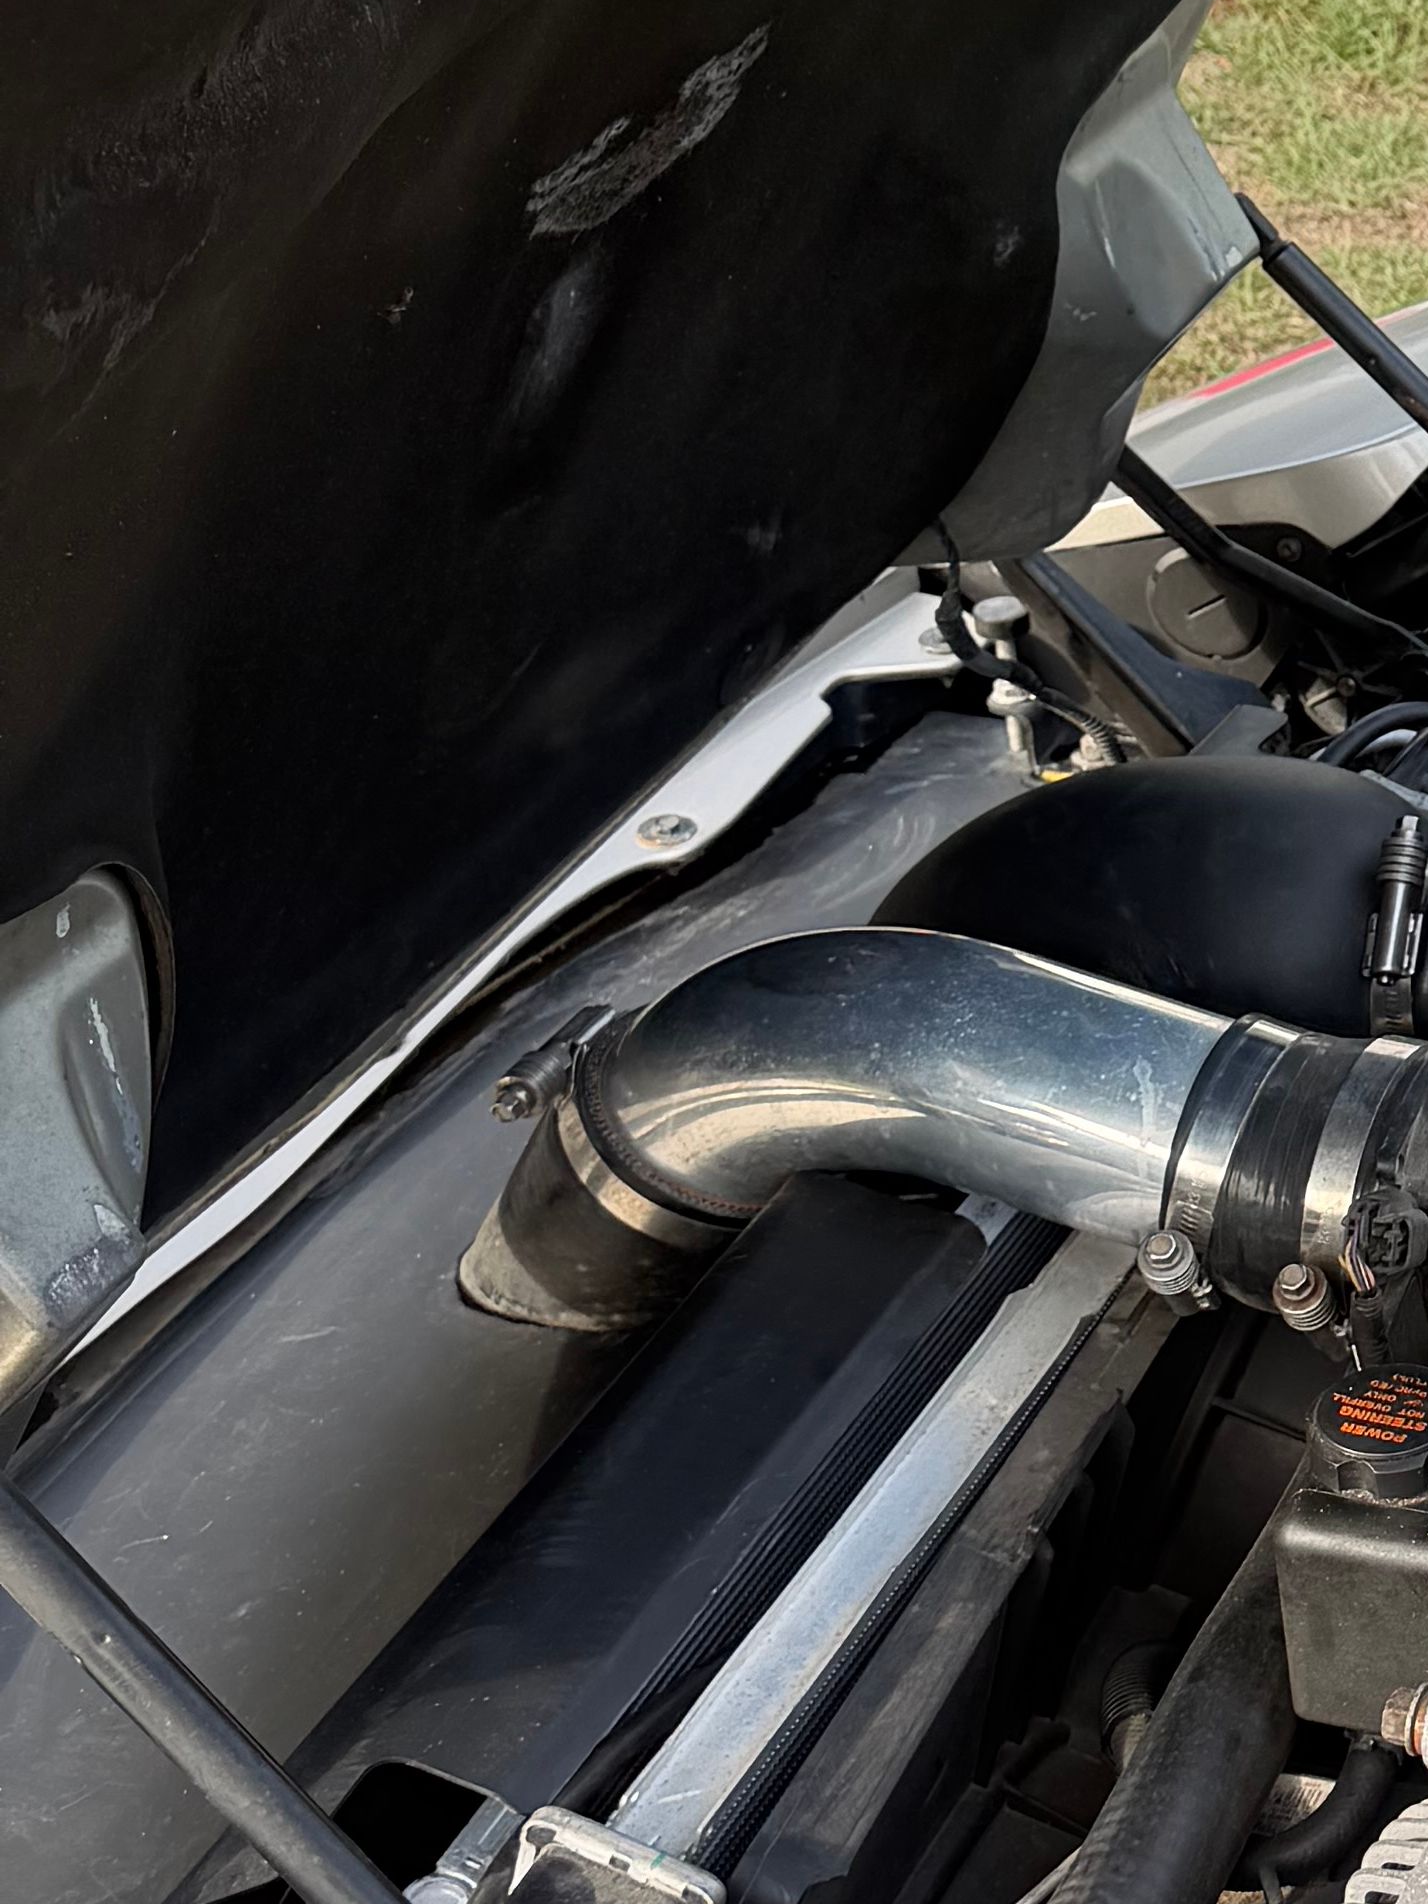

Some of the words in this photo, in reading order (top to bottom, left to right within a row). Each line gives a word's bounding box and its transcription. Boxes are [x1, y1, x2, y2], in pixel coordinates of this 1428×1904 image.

[1333, 1392, 1391, 1412] OVERFILL
[1364, 1391, 1396, 1401] ONLY
[1339, 1406, 1427, 1431] STEERING
[1398, 1409, 1425, 1418] NOT
[1340, 1423, 1407, 1443] POWER
